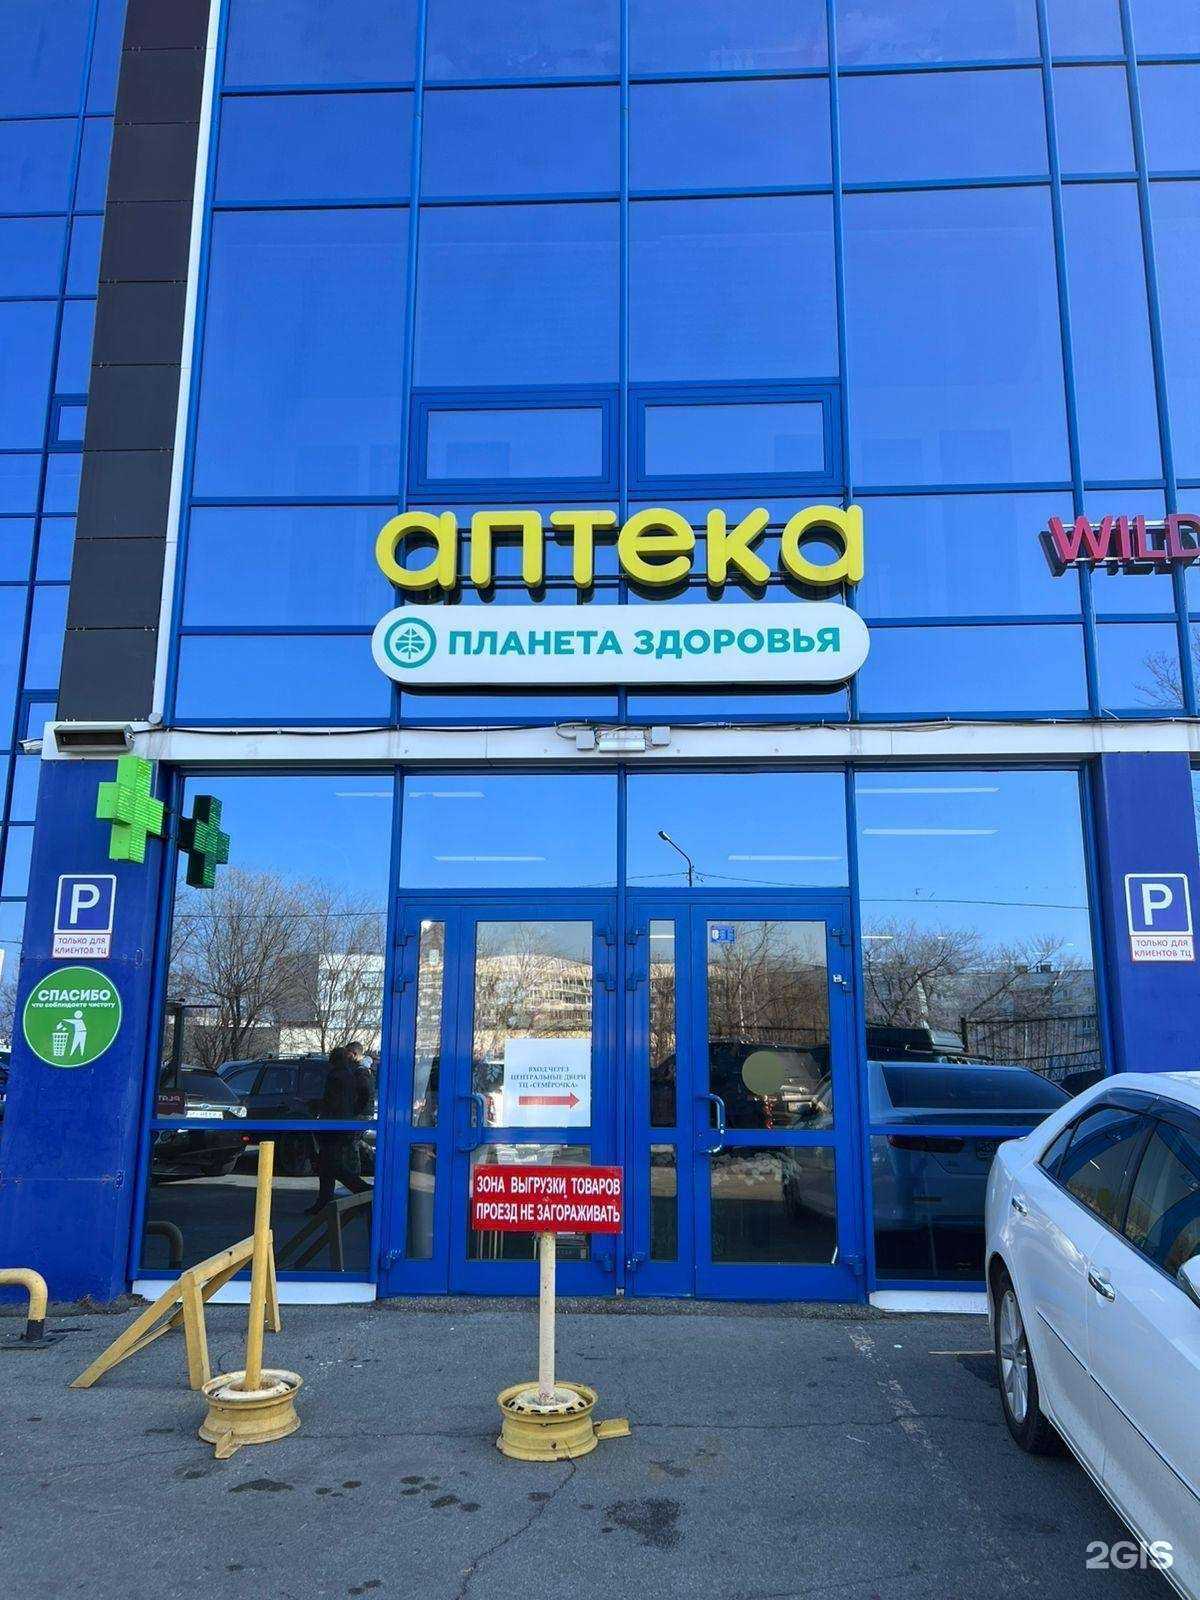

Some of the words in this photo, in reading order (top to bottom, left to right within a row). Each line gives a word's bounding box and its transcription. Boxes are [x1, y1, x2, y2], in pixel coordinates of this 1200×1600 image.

[375, 505, 864, 590] аптека
[448, 629, 624, 656] ПЛАНЕТА
[633, 627, 841, 660] ЗДОРОВЬЯ
[69, 884, 100, 924] P
[1141, 883, 1173, 926] P
[59, 937, 87, 945] ТОЛЬКО
[89, 937, 106, 946] ДЛЯ
[1171, 940, 1188, 948] ДЛЯ
[97, 948, 107, 956] ТЦ
[1181, 950, 1192, 958] ТЦ
[38, 989, 111, 1001] СПАСИБО
[476, 1175, 505, 1193] ЗОНА
[510, 1176, 566, 1194] ВЫГРУЗКИ
[571, 1177, 621, 1195] ТОВАРОВ
[476, 1202, 518, 1223] ПРОЕЗД
[520, 1204, 534, 1220] НЕ
[536, 1204, 621, 1222] ЗАГОРАЖИВАТЬ
